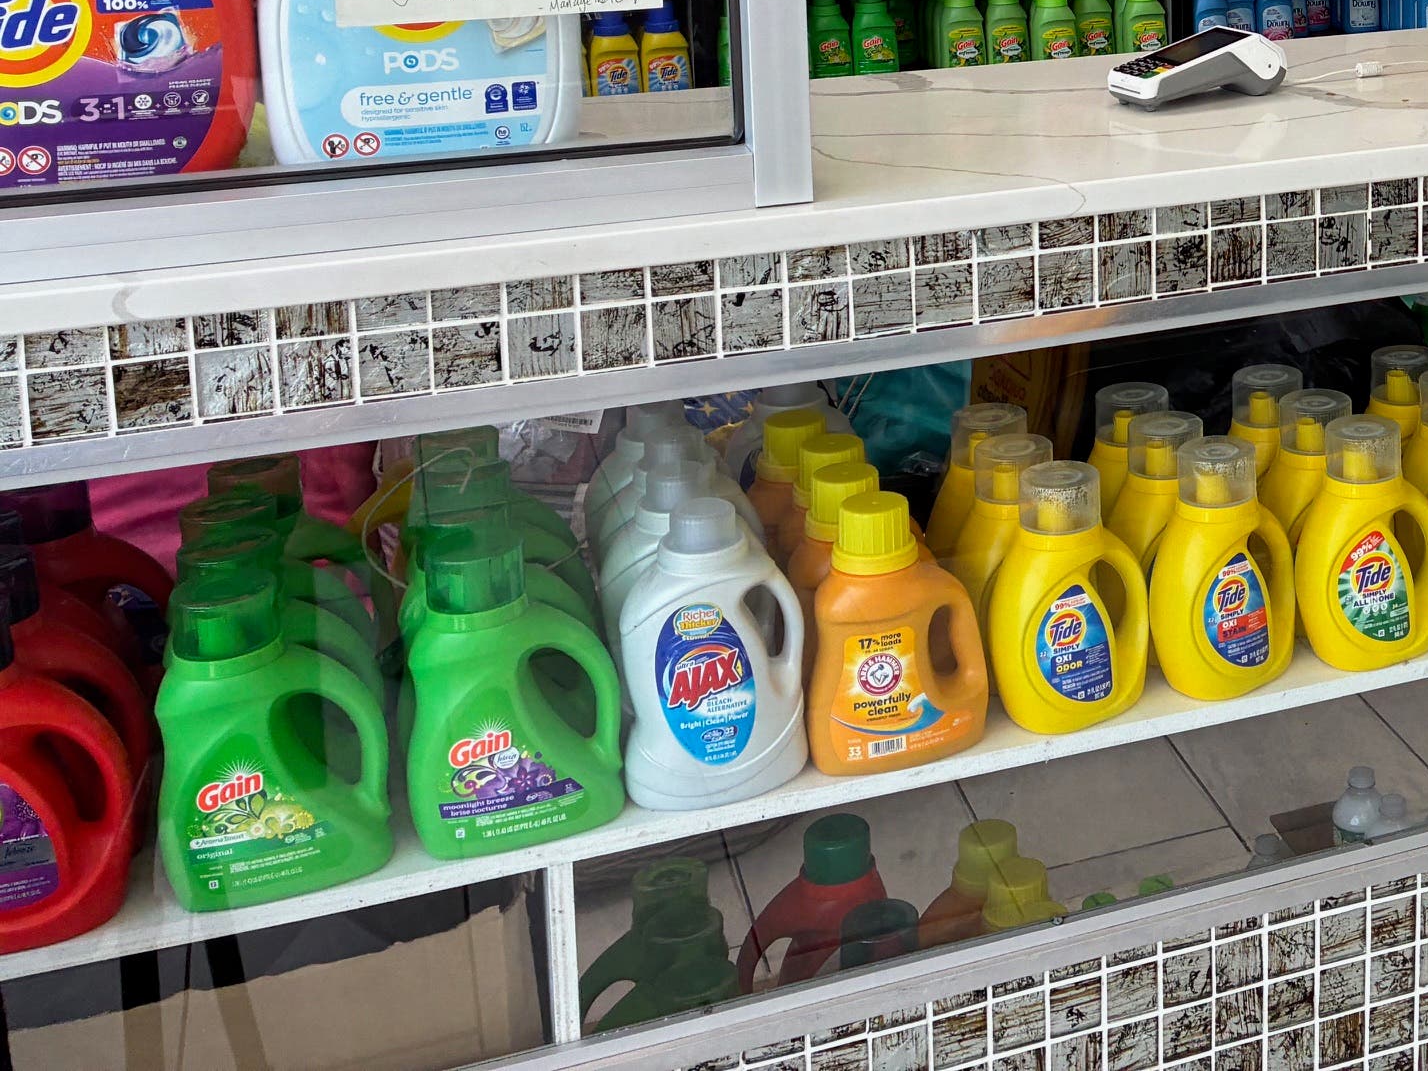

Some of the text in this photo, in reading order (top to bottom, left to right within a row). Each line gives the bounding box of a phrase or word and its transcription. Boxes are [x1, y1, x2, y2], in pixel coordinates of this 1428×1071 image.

[384, 47, 460, 74] PODS
[359, 91, 394, 106] free
[417, 86, 473, 106] gentle
[0, 100, 62, 125] ODS
[1355, 561, 1392, 594] Tide
[1217, 584, 1246, 612] Tide
[683, 608, 717, 621] Richer
[1222, 619, 1238, 629] OXI
[1050, 619, 1083, 647] Tide
[1053, 643, 1081, 655] SIMPLY
[1055, 654, 1072, 664] OXI
[1056, 661, 1083, 673] ODOR
[668, 650, 740, 710] AJAX
[854, 692, 911, 711] powerfully
[868, 705, 898, 716] clean
[449, 730, 511, 768] Gain
[197, 773, 262, 812] Gain
[443, 795, 515, 811] moonlight breeze
[197, 848, 233, 860] original
